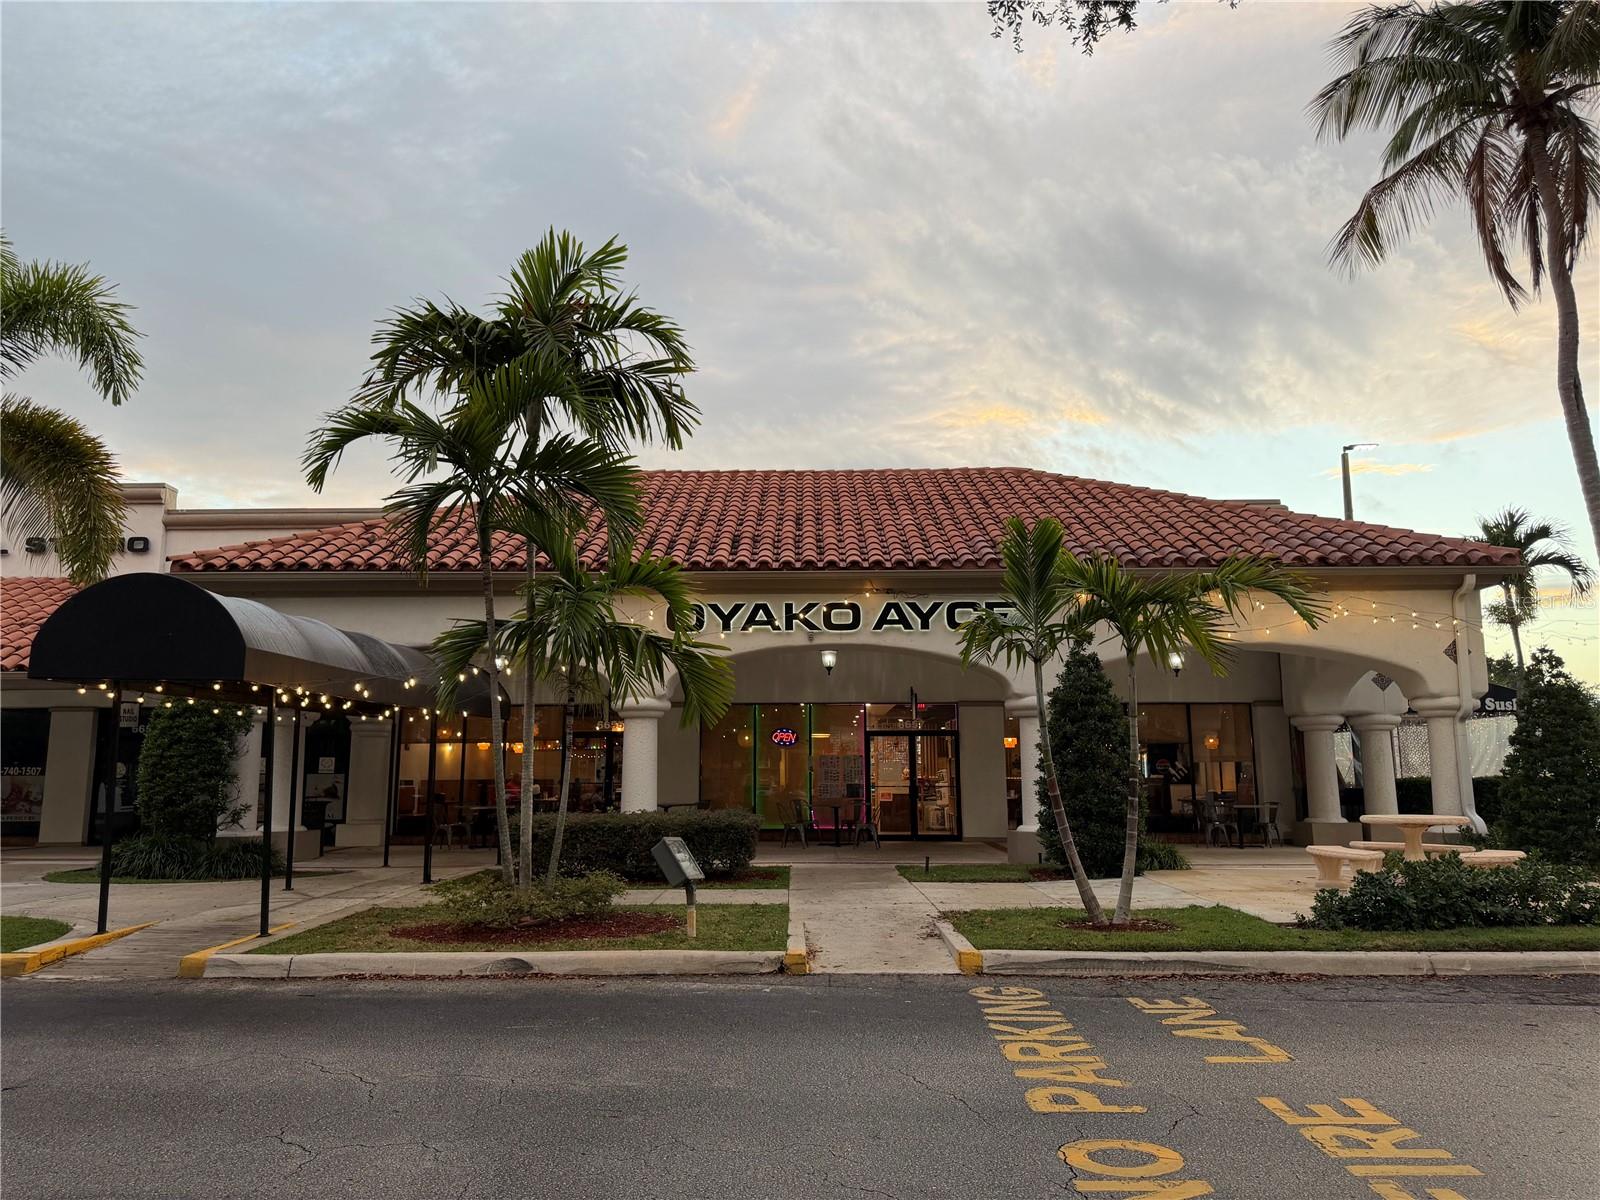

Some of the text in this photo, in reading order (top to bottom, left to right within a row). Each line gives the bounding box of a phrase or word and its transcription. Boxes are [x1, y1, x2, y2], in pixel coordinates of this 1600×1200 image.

[666, 602, 862, 632] OYAKO
[772, 732, 797, 742] OPEN
[968, 986, 1149, 1114] PARKING
[1126, 996, 1295, 1064] LANE
